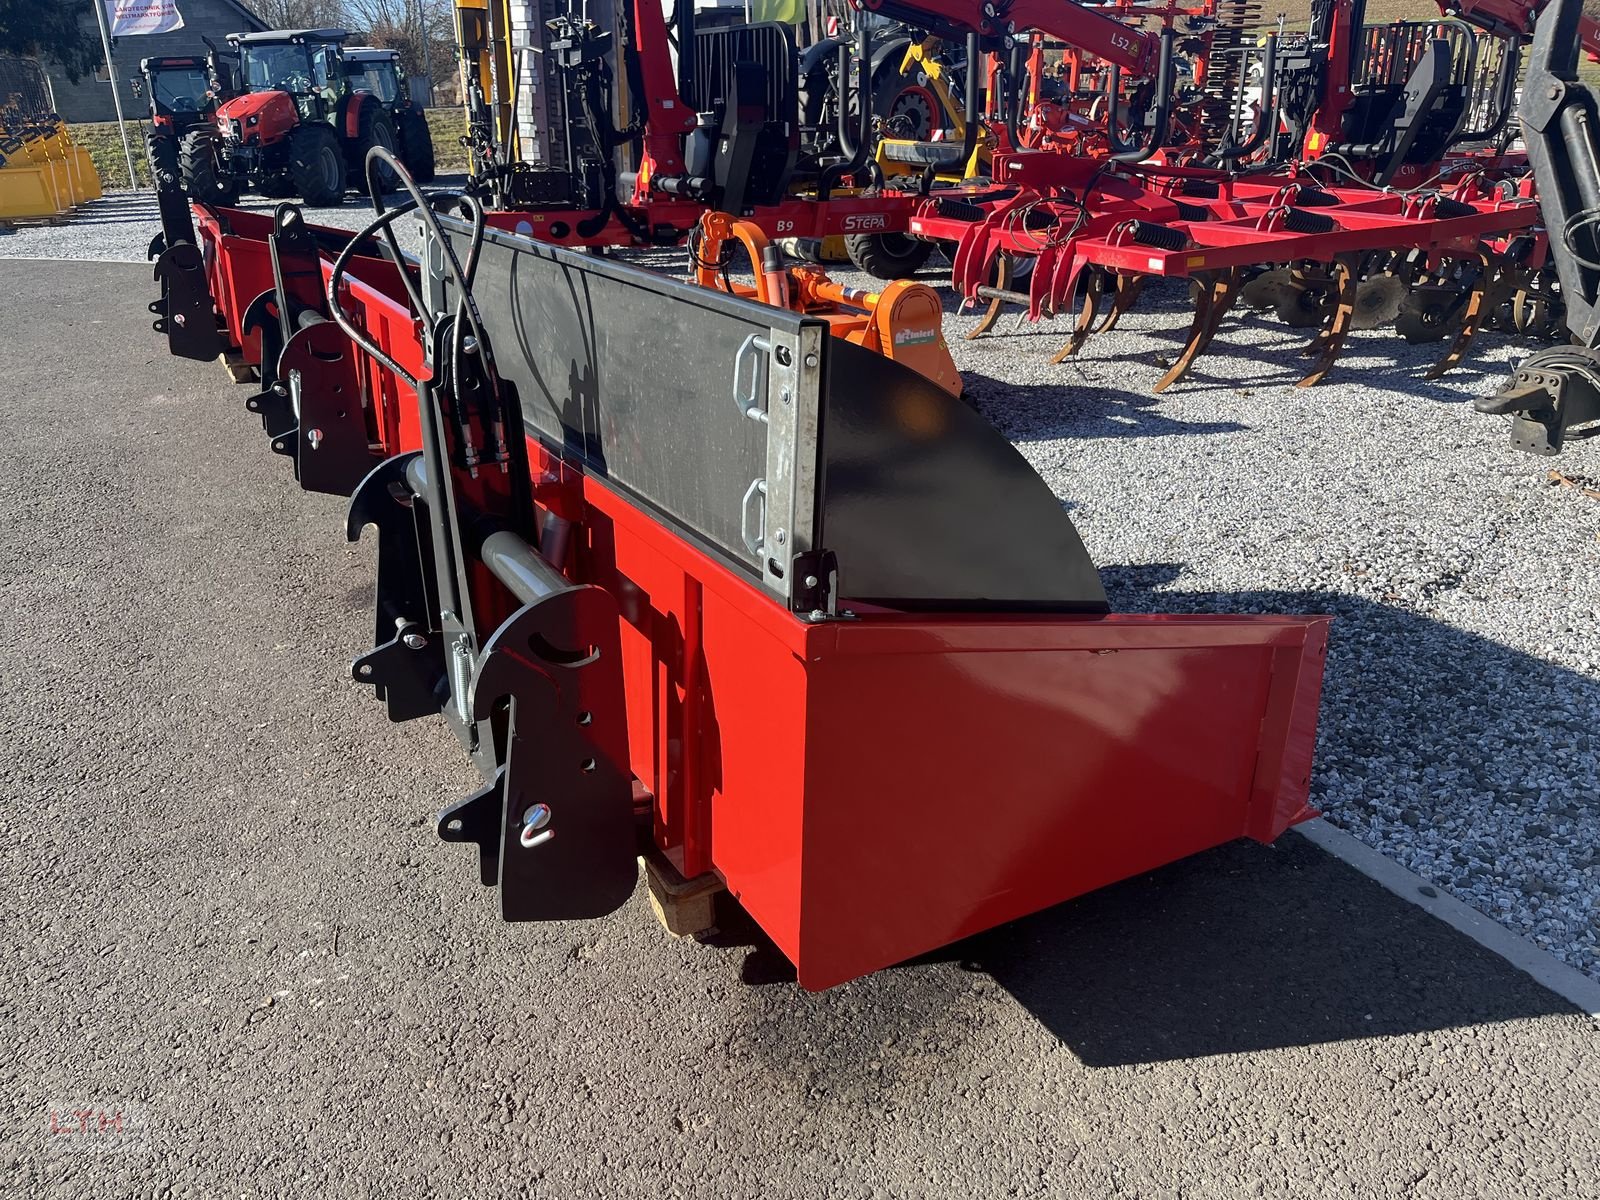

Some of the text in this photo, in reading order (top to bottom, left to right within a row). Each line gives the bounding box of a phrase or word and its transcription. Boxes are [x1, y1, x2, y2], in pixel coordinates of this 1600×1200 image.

[114, 5, 160, 13] LANDTECHNIK
[1111, 32, 1129, 50] L52
[1401, 165, 1415, 175] C10
[776, 220, 794, 232] B9
[844, 215, 885, 230] STEPA
